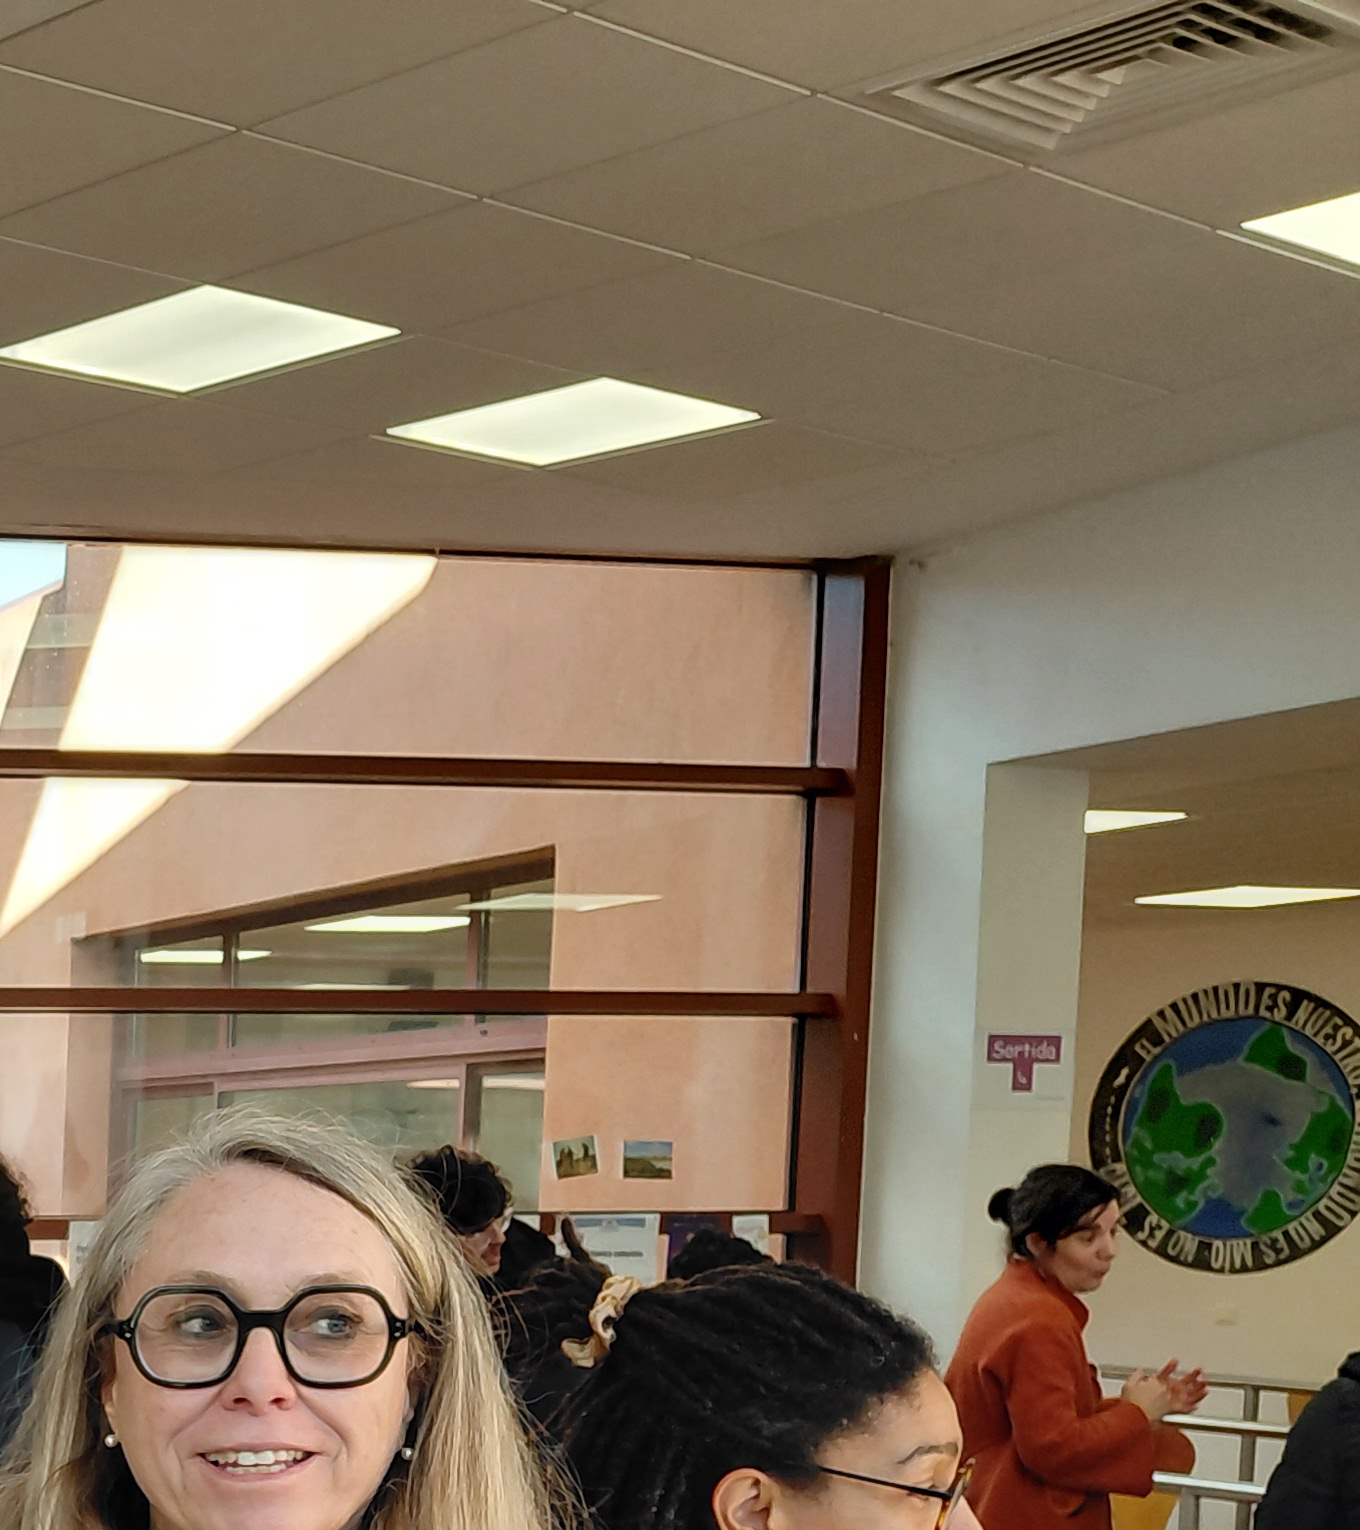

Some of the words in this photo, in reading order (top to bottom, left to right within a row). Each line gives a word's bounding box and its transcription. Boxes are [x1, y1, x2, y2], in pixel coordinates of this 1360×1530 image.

[1134, 1036, 1166, 1061] EL
[1150, 982, 1256, 1044] MUNDO
[1259, 986, 1291, 1021] ES
